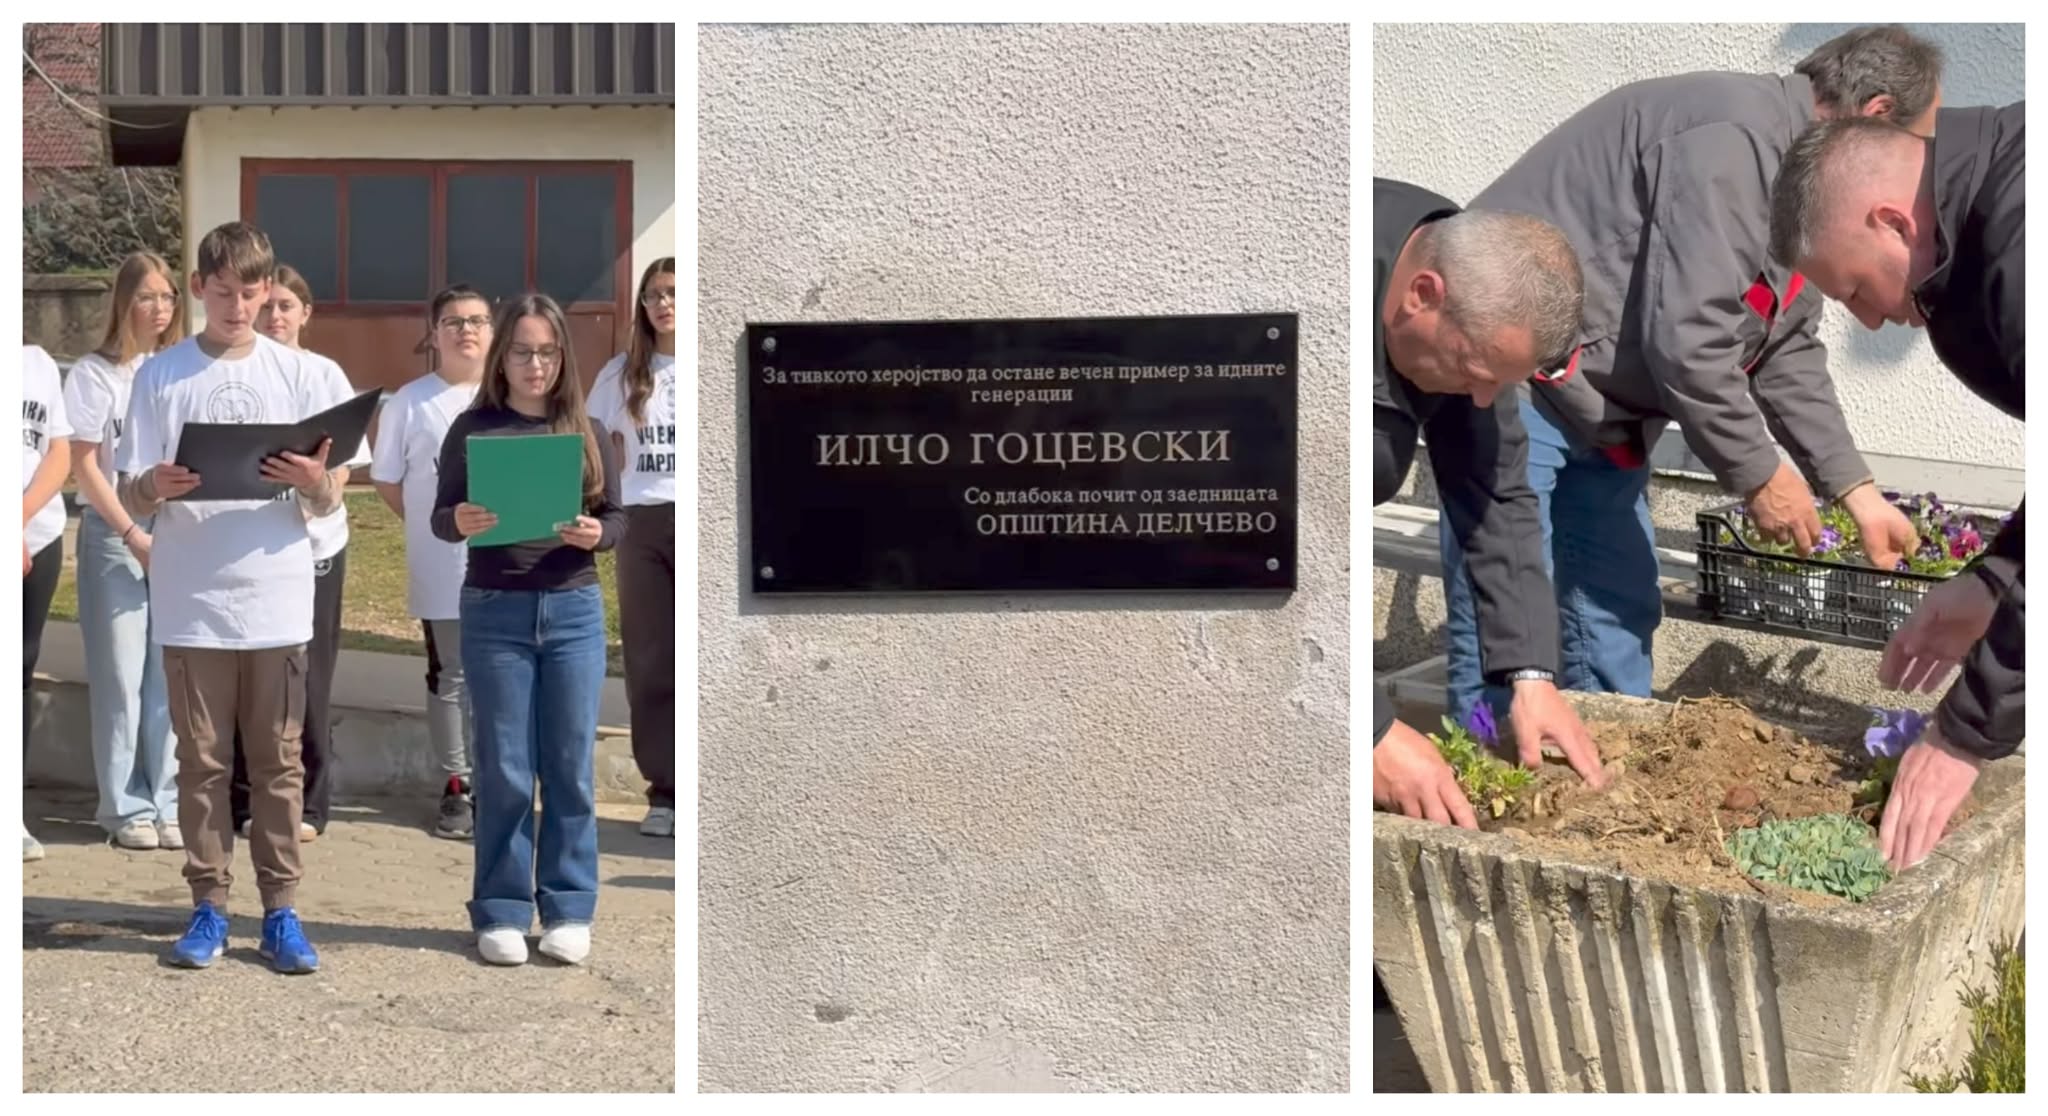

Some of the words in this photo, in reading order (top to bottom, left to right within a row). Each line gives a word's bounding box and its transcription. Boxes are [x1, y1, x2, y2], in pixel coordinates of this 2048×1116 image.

[764, 366, 786, 384] За
[790, 370, 868, 383] тивкото
[872, 365, 963, 386] херојство
[966, 368, 988, 383] да
[991, 367, 1055, 381] остане
[1059, 366, 1114, 380] вечен
[1118, 365, 1190, 383] пример
[1194, 364, 1213, 378] за
[1218, 363, 1286, 379] идните
[971, 388, 1073, 406] генерации
[817, 433, 949, 466] ИЛЧО
[970, 430, 1231, 470] ГОЦЕВСКИ
[964, 487, 991, 504] Со
[994, 487, 1073, 505] длабока
[1078, 490, 1137, 503] почит
[1140, 489, 1163, 504] од
[1167, 488, 1278, 502] заедницата
[977, 513, 1131, 535] ОПШТИНА
[1135, 511, 1277, 537] ДЕЛЧЕВО
